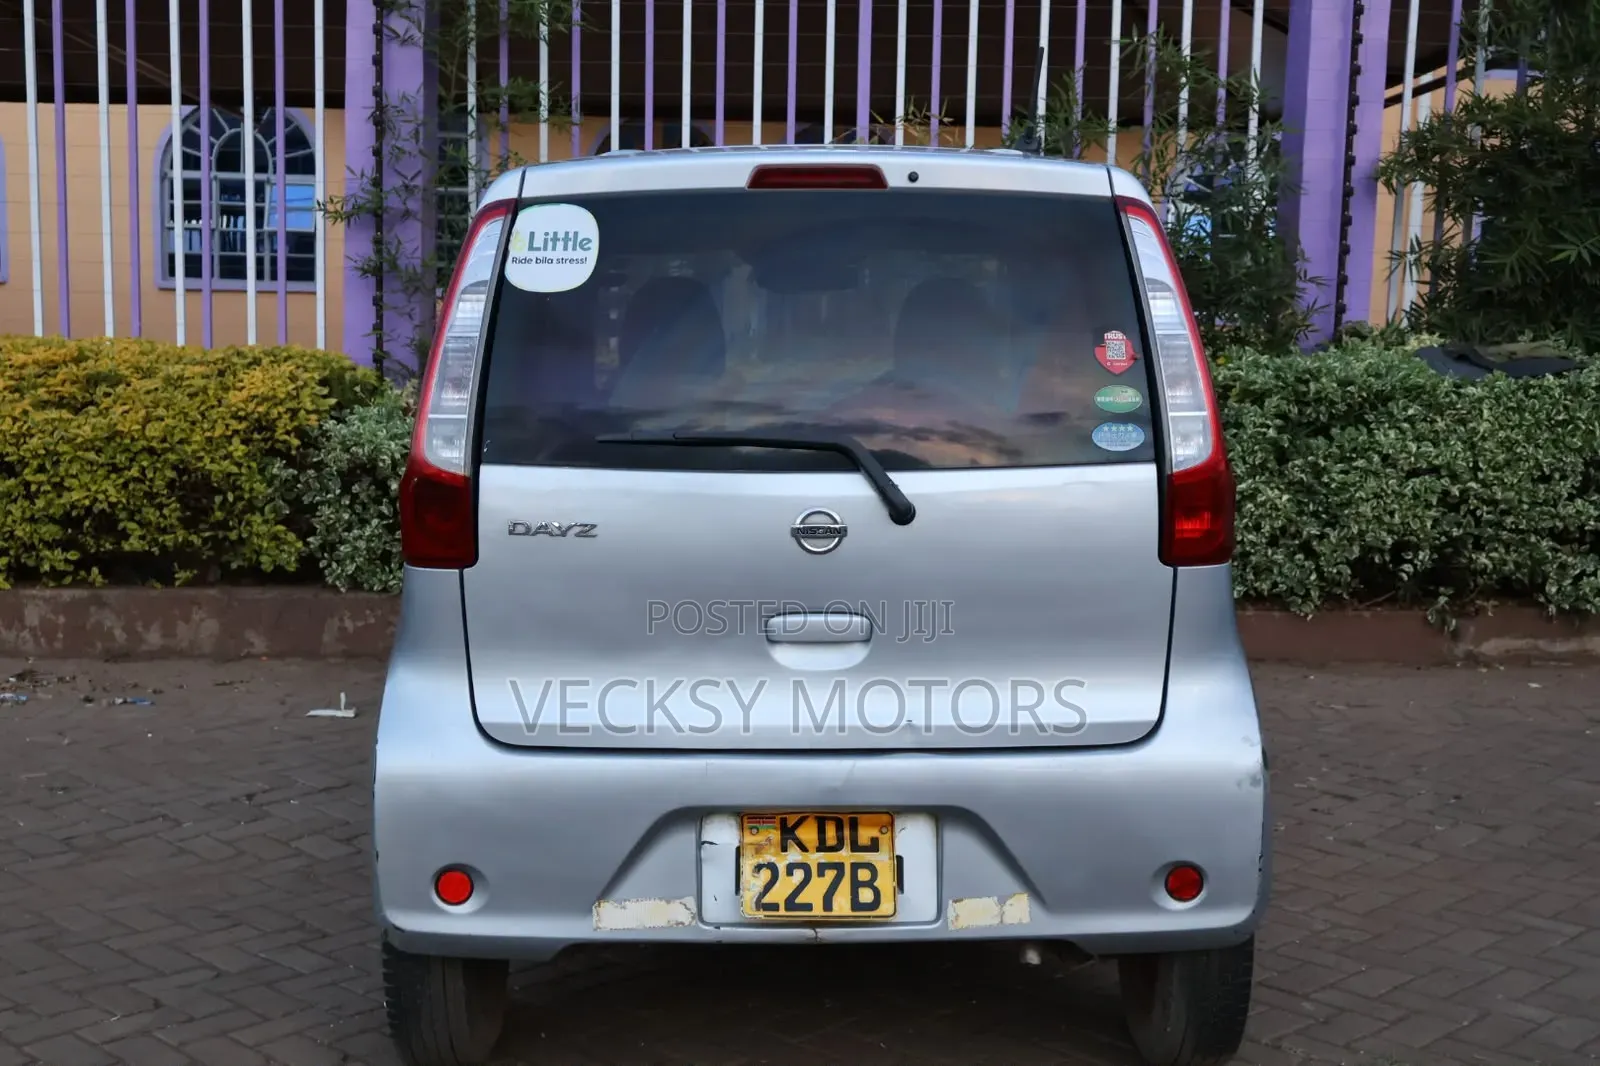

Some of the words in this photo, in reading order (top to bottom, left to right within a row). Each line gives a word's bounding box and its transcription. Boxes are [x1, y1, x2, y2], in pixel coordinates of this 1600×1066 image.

[527, 231, 593, 252] Little
[511, 256, 533, 265] Ride
[535, 256, 554, 265] bila
[555, 256, 588, 265] stress!
[508, 520, 598, 538] DAYZ
[796, 527, 842, 535] NISSAN
[780, 816, 879, 853] KDL
[753, 862, 881, 912] 227B
